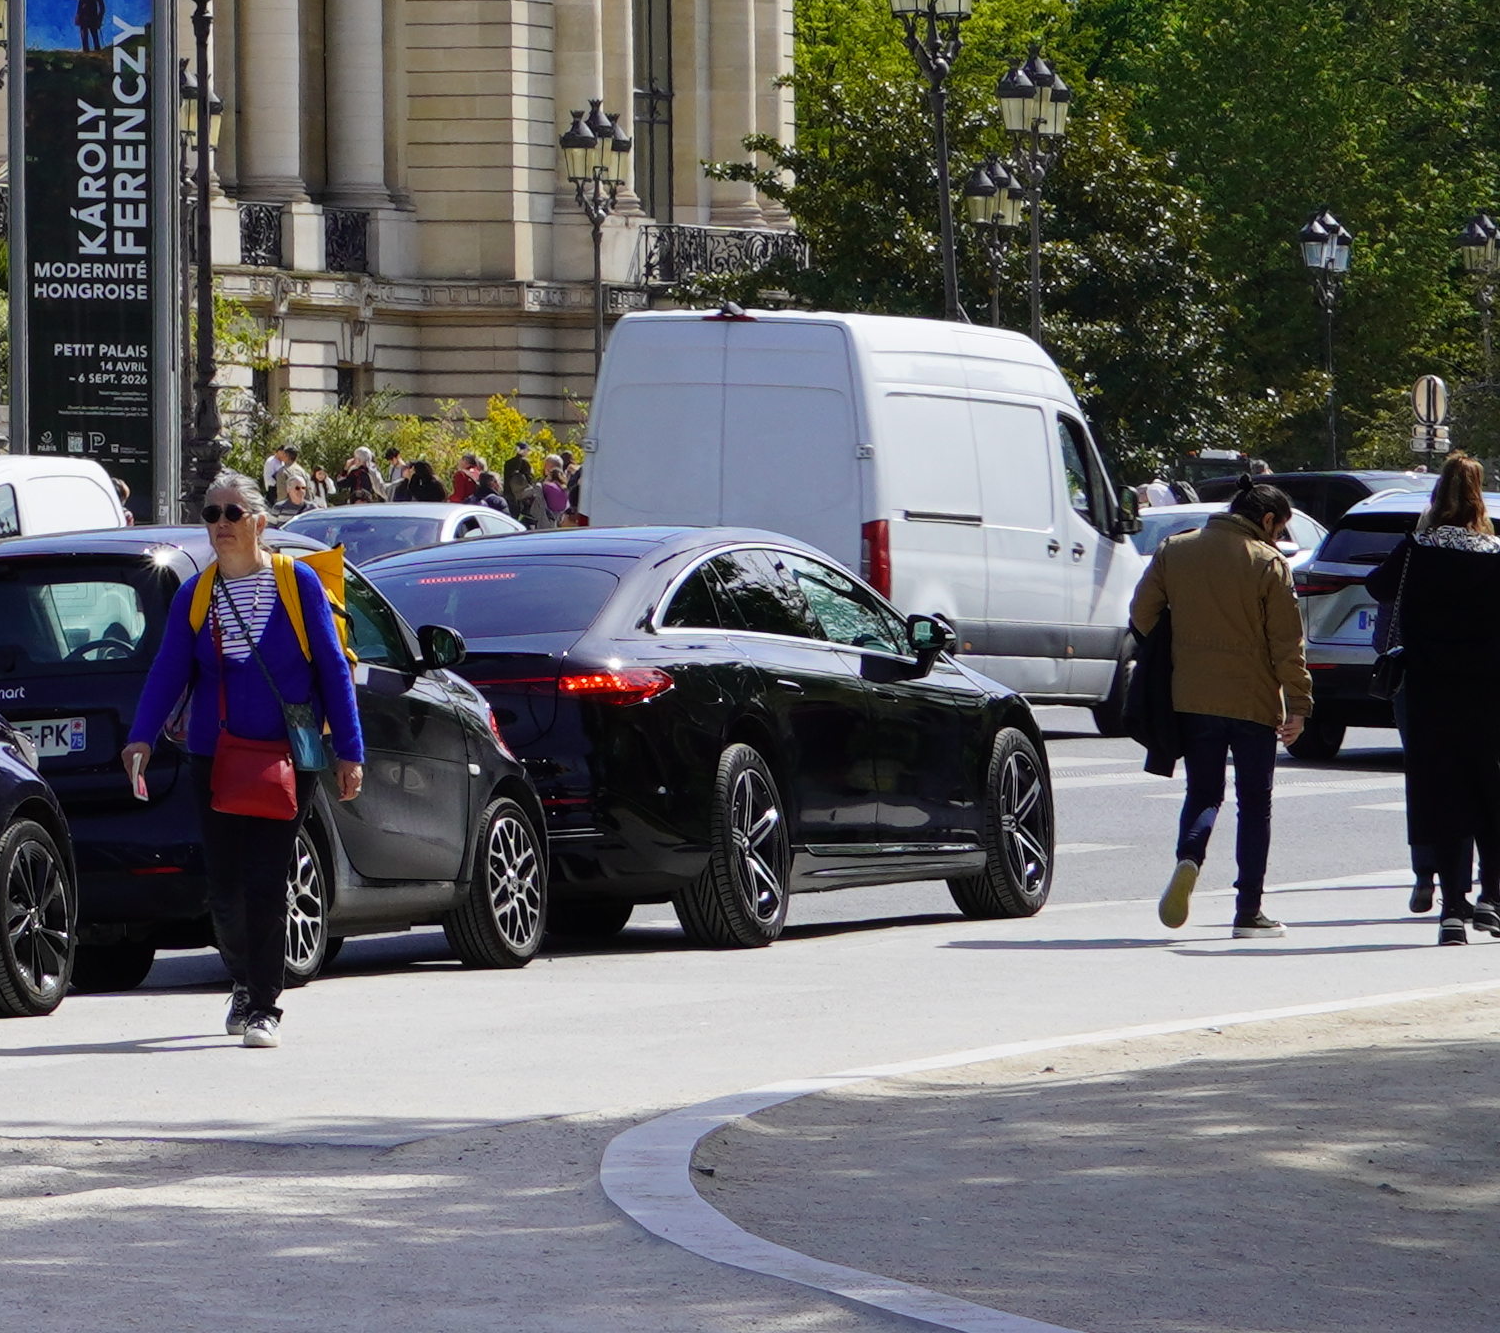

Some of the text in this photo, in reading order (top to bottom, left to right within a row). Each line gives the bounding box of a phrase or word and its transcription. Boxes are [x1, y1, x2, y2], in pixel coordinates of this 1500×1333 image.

[112, 14, 147, 255] FERENCZY
[70, 97, 107, 255] KÁROLY
[34, 260, 147, 279] MODERNITÉ
[34, 283, 147, 300] HONGROISE
[54, 343, 148, 358] PETIT PALAIS
[100, 361, 147, 371] 14 AVRIL
[78, 373, 85, 383] 6
[88, 373, 118, 384] SEPT.
[121, 374, 148, 384] 2026
[72, 735, 83, 747] 75
